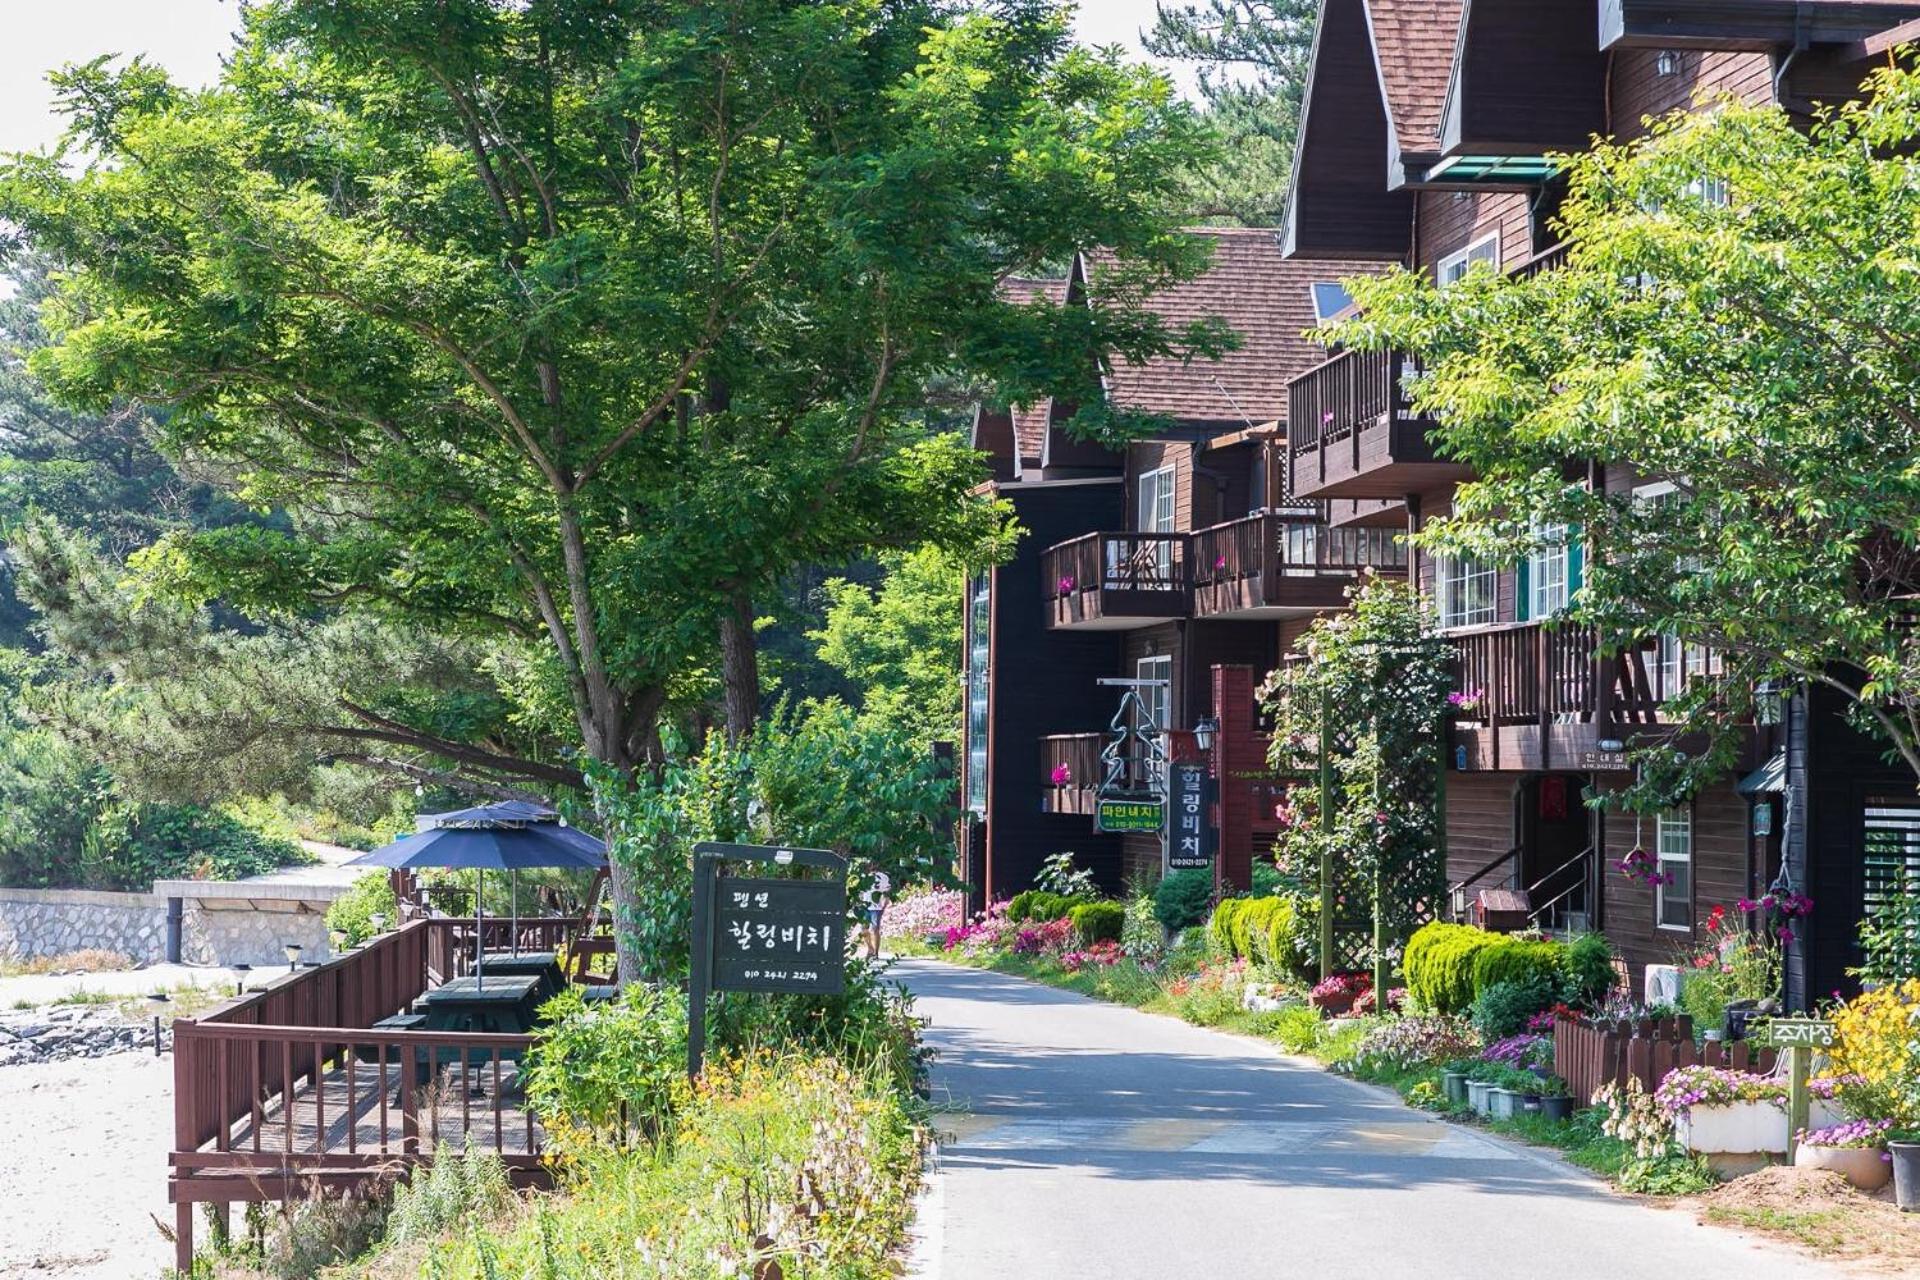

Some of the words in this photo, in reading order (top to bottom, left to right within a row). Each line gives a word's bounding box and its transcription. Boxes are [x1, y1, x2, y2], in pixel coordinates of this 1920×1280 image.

[1181, 771, 1201, 856] 힐링비치
[744, 970, 760, 979] 010
[764, 970, 787, 980] 2421
[792, 971, 818, 982] 2274
[1773, 1024, 1837, 1046] 주차장
